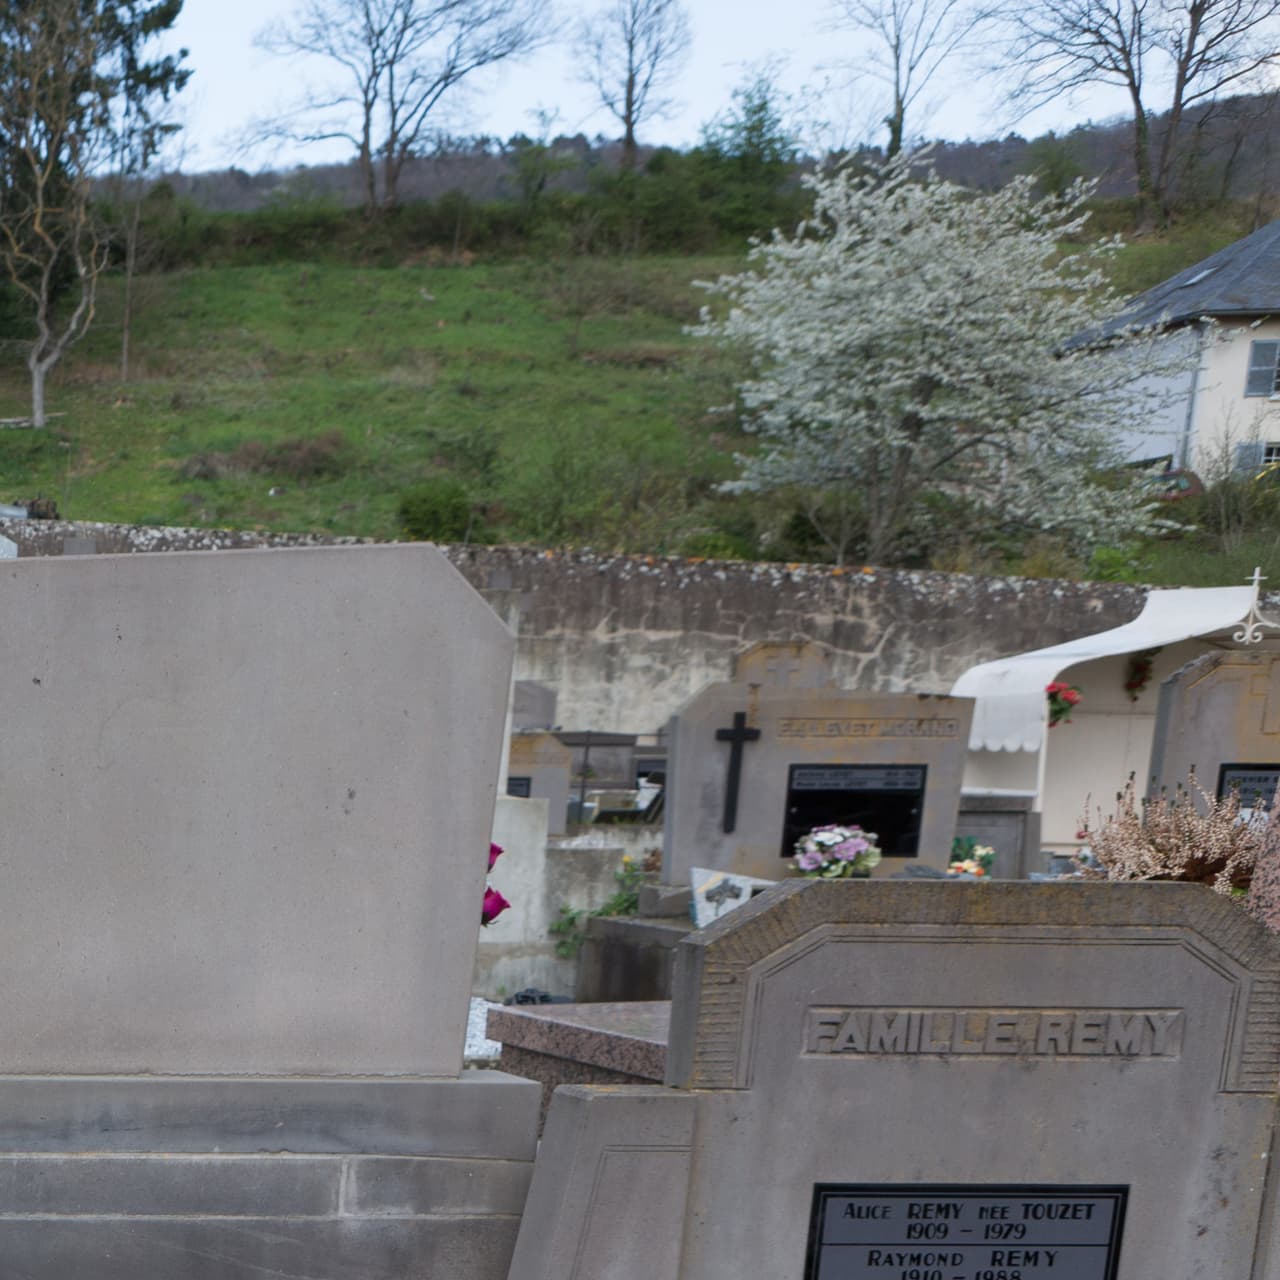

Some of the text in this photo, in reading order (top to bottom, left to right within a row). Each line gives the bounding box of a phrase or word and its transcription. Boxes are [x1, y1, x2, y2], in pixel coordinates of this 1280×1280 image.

[810, 1011, 1178, 1057] FAMILLE REMY
[907, 1203, 964, 1219] REMY
[1022, 1203, 1096, 1220] TOUZET
[906, 1223, 949, 1240] 1909
[984, 1223, 1026, 1239] 1979
[991, 1250, 1059, 1267] REMY
